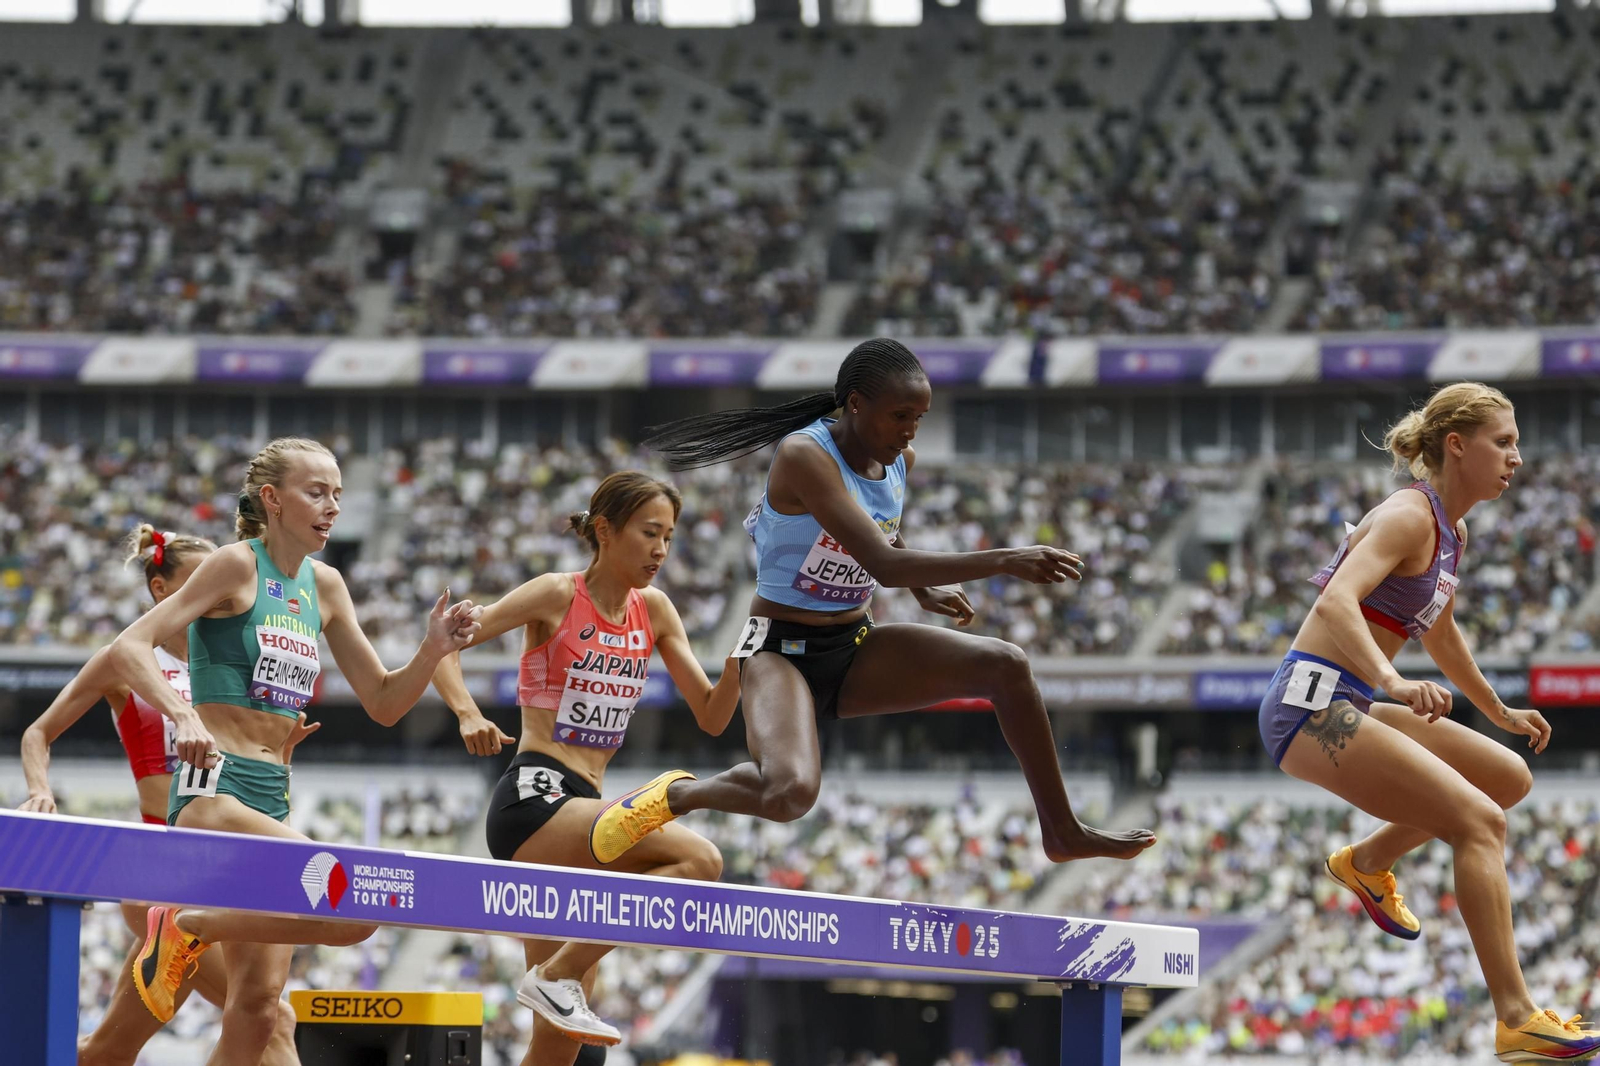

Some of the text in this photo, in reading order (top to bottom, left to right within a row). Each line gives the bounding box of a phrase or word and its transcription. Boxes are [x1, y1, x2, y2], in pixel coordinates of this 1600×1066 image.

[260, 633, 318, 660] HONDA
[741, 618, 758, 651] 2
[257, 656, 317, 692] FEAIN-RYAN
[572, 650, 647, 679] JAPAN
[568, 676, 642, 699] HONDA
[1304, 671, 1322, 703] 1
[569, 702, 629, 729] SAITO
[352, 877, 415, 894] CHAMPIONSHIPS
[353, 864, 415, 881] WORLD ATHLETICS
[482, 880, 840, 945] WORLD ATHLETICS CHAMPIONSHIPS
[1164, 952, 1194, 976] NISHI
[311, 996, 403, 1018] SEIKO
